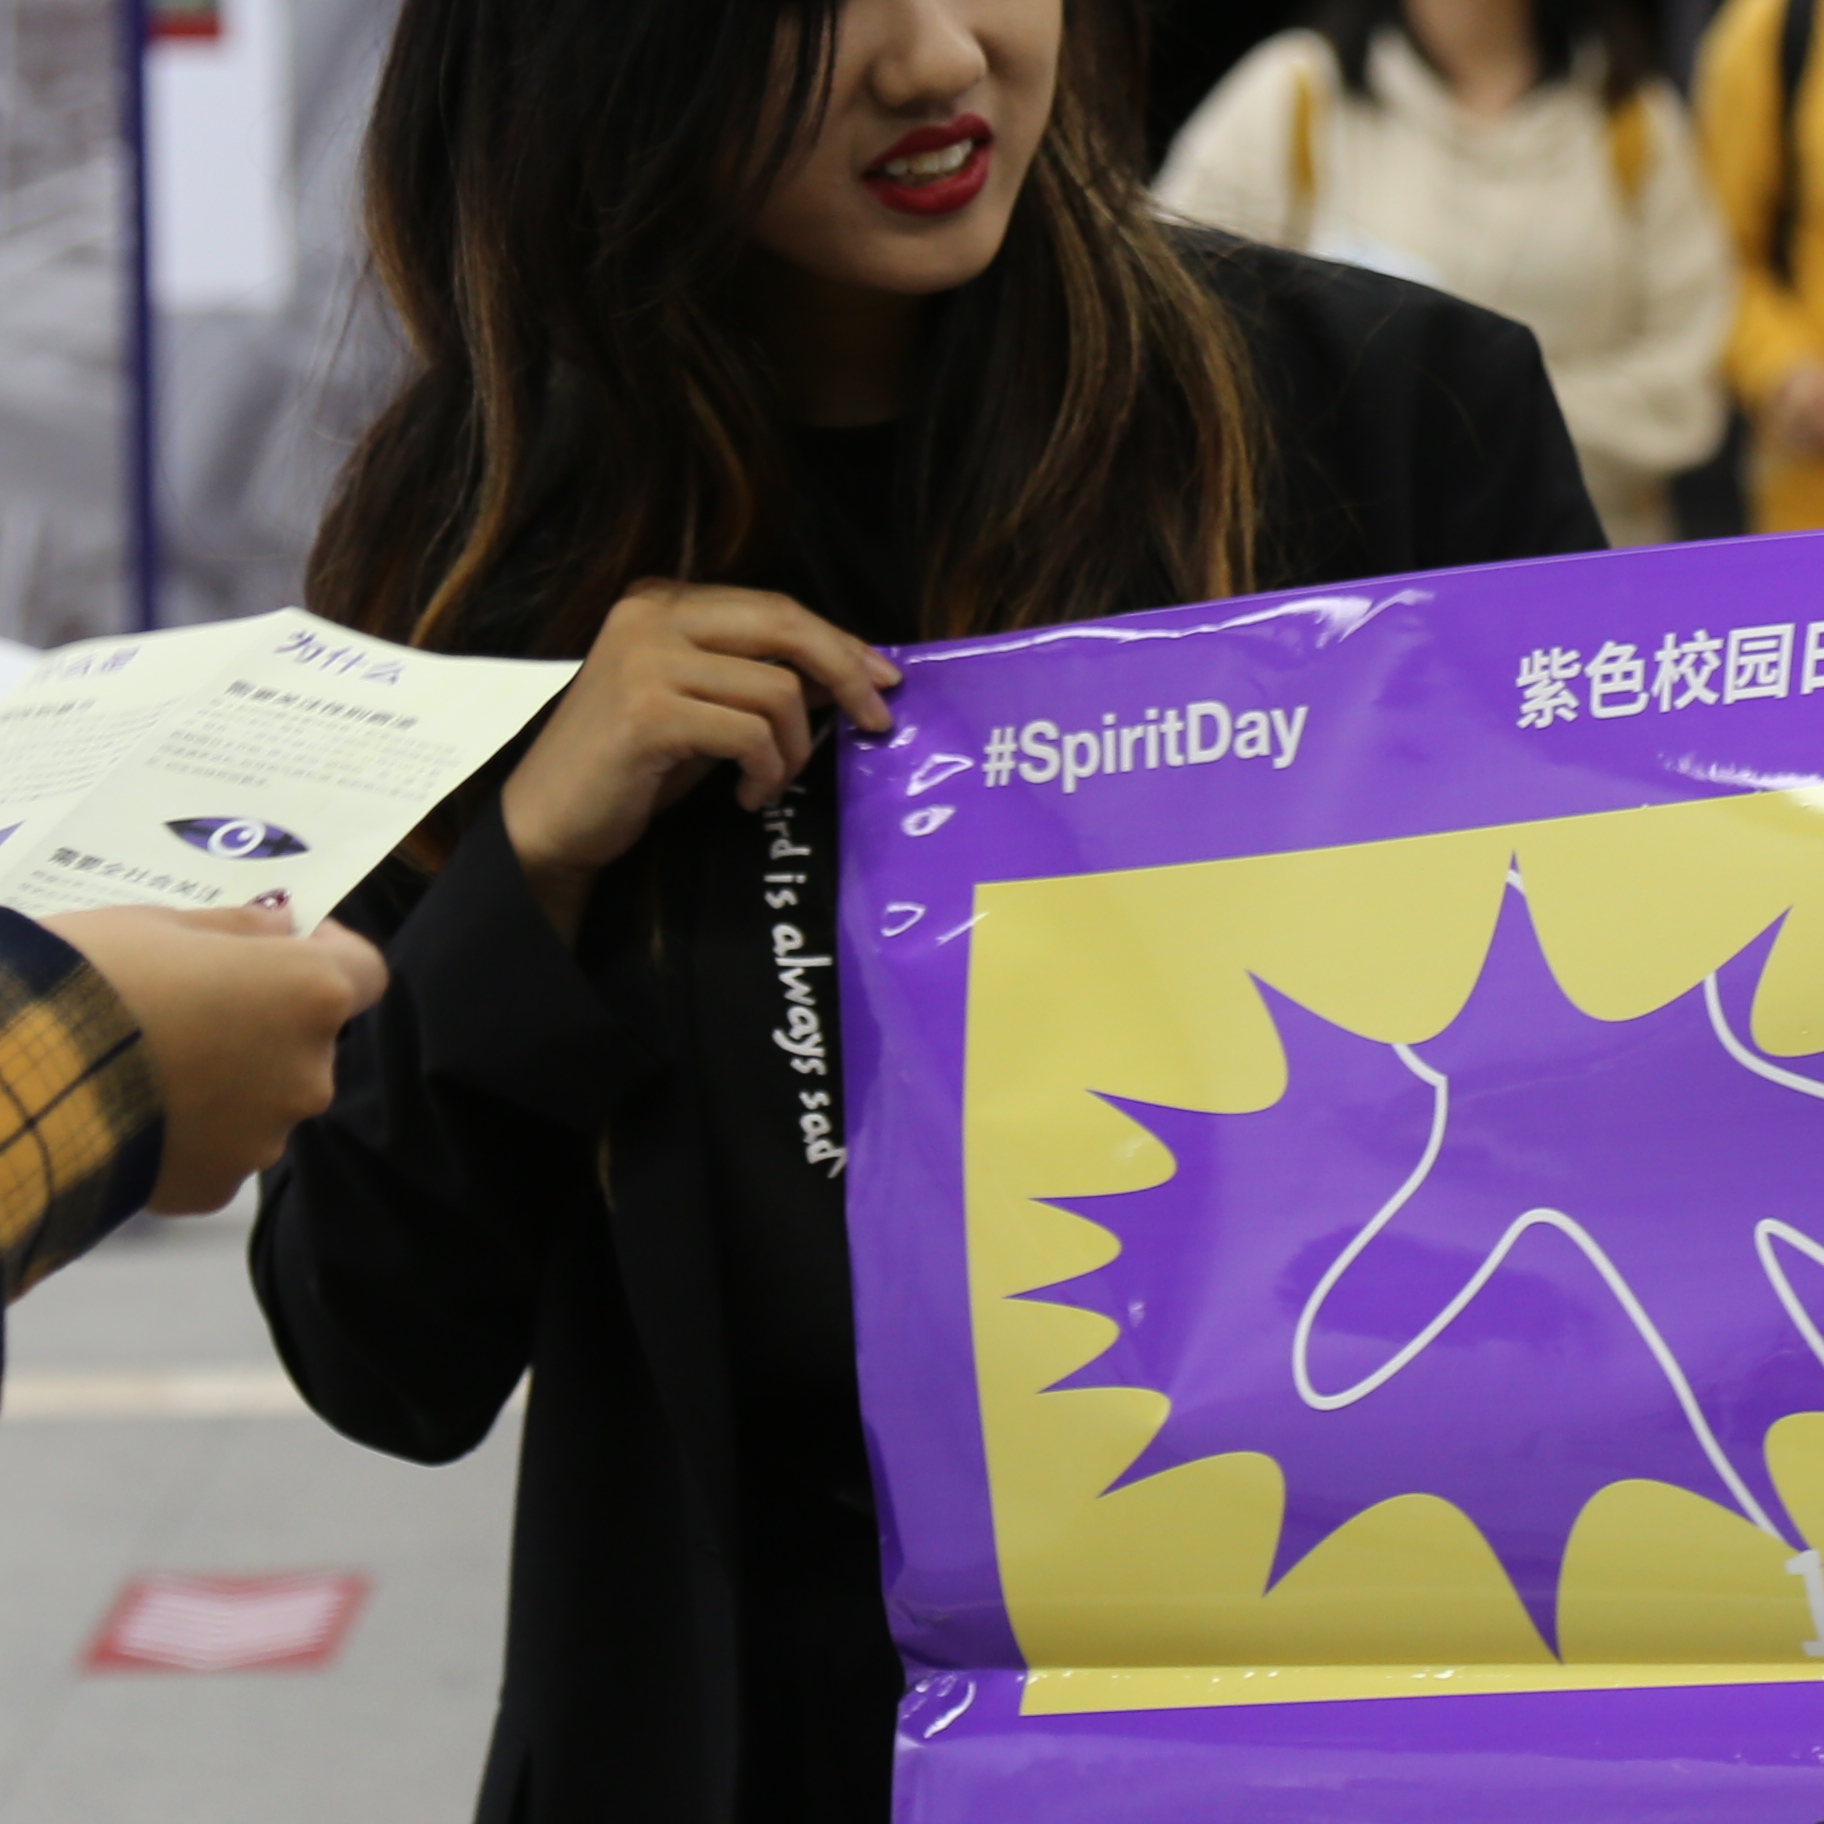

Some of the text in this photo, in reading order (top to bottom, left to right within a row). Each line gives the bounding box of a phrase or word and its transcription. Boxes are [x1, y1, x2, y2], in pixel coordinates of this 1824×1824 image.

[273, 630, 405, 686] 为什么
[982, 700, 1309, 794] #SpiritDay
[763, 872, 808, 909] is
[771, 922, 833, 1076] always
[798, 1090, 848, 1179] sad
